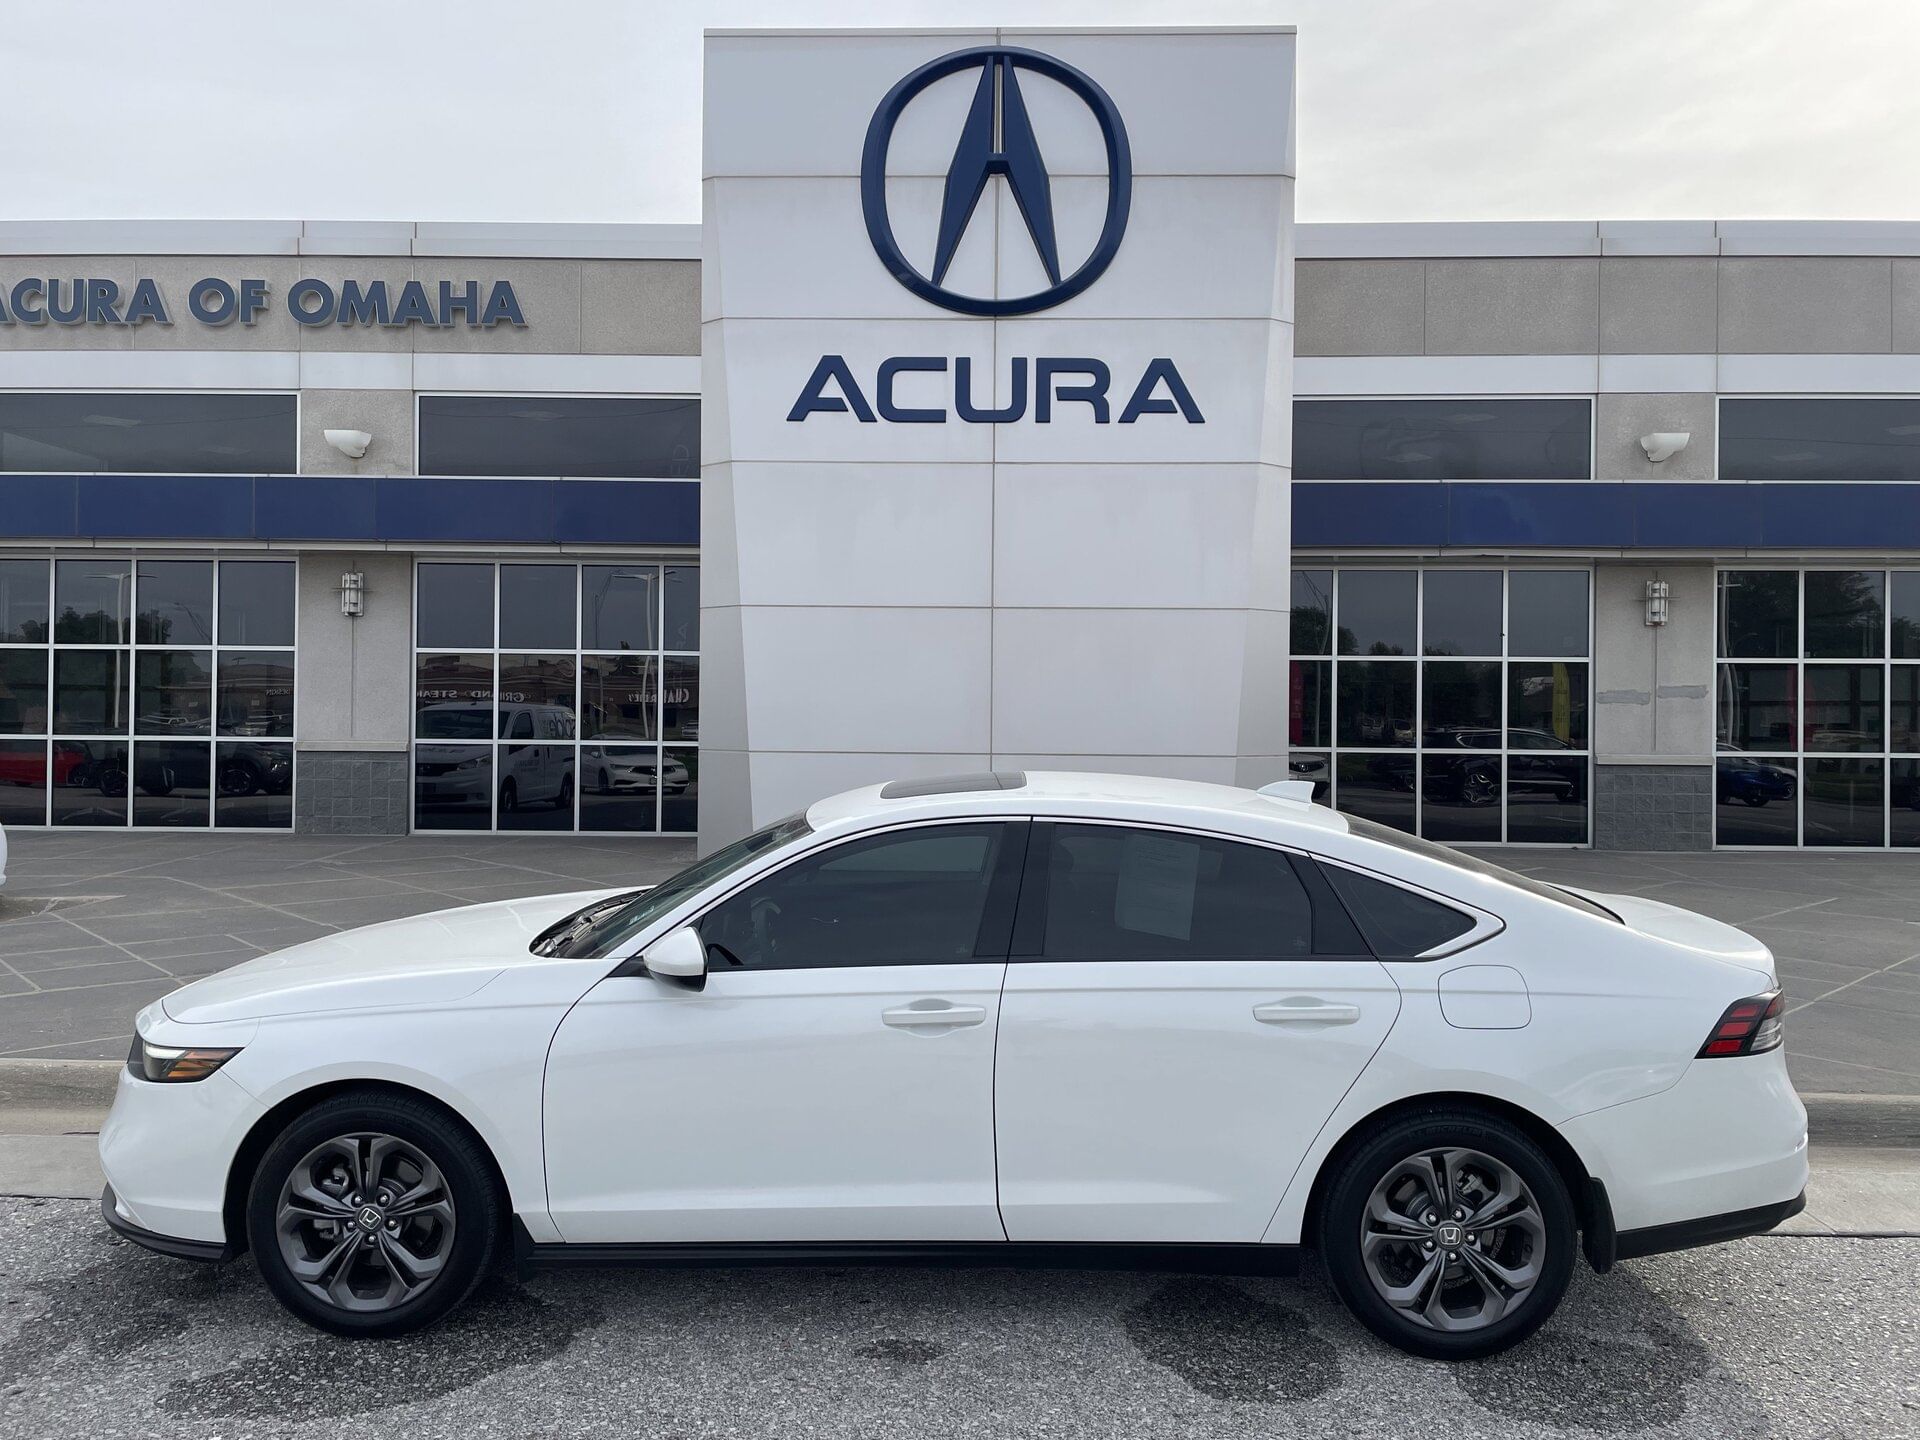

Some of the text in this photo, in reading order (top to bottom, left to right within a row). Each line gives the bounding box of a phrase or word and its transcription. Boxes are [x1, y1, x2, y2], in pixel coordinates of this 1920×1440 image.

[0, 278, 528, 327] CURA OF OMAHA
[786, 355, 1206, 424] ACURA
